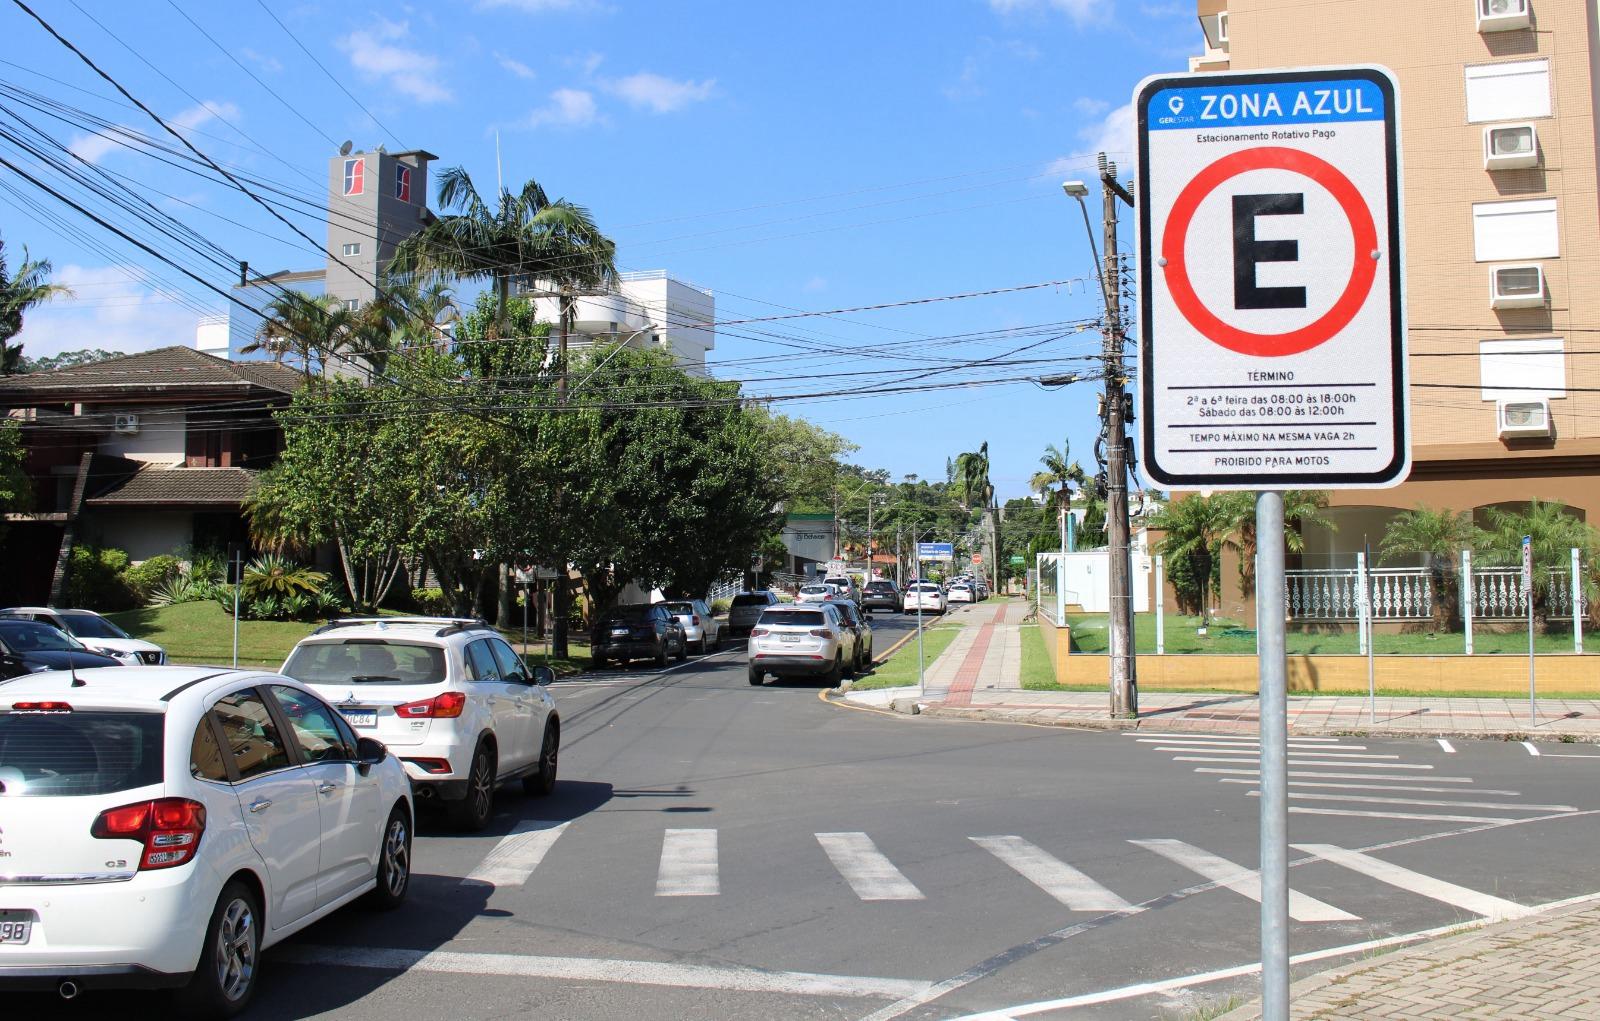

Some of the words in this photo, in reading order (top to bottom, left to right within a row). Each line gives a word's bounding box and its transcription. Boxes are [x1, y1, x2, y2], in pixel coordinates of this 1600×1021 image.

[1200, 93, 1283, 120] ZONA
[1292, 88, 1373, 116] AZUL
[1197, 133, 1269, 143] Estacionamento
[1272, 131, 1310, 140] Rotativo
[1313, 130, 1335, 140] Pago
[1232, 192, 1307, 308] E
[1248, 370, 1294, 381] TÉRMINO
[1202, 397, 1207, 405] a
[1225, 395, 1247, 404] feira
[1251, 394, 1268, 404] das
[1271, 395, 1303, 403] 08:00
[1307, 393, 1317, 403] às
[1321, 394, 1356, 403] 18:00h
[1199, 407, 1236, 417] Sábado
[1239, 407, 1256, 416] das
[1259, 407, 1291, 416] 08:00
[1295, 406, 1305, 415] às
[1309, 406, 1344, 415] 12:00h
[1190, 433, 1220, 442] TEMPO
[1223, 431, 1259, 441] MÁXIMO
[1263, 433, 1276, 441] NA
[1279, 432, 1311, 441] MESMA
[1314, 432, 1340, 440] VAGA
[1343, 432, 1354, 440] 2h
[1215, 457, 1261, 466] PROIBIDO
[1265, 457, 1292, 467] PARA
[1296, 457, 1329, 465] MOTOS
